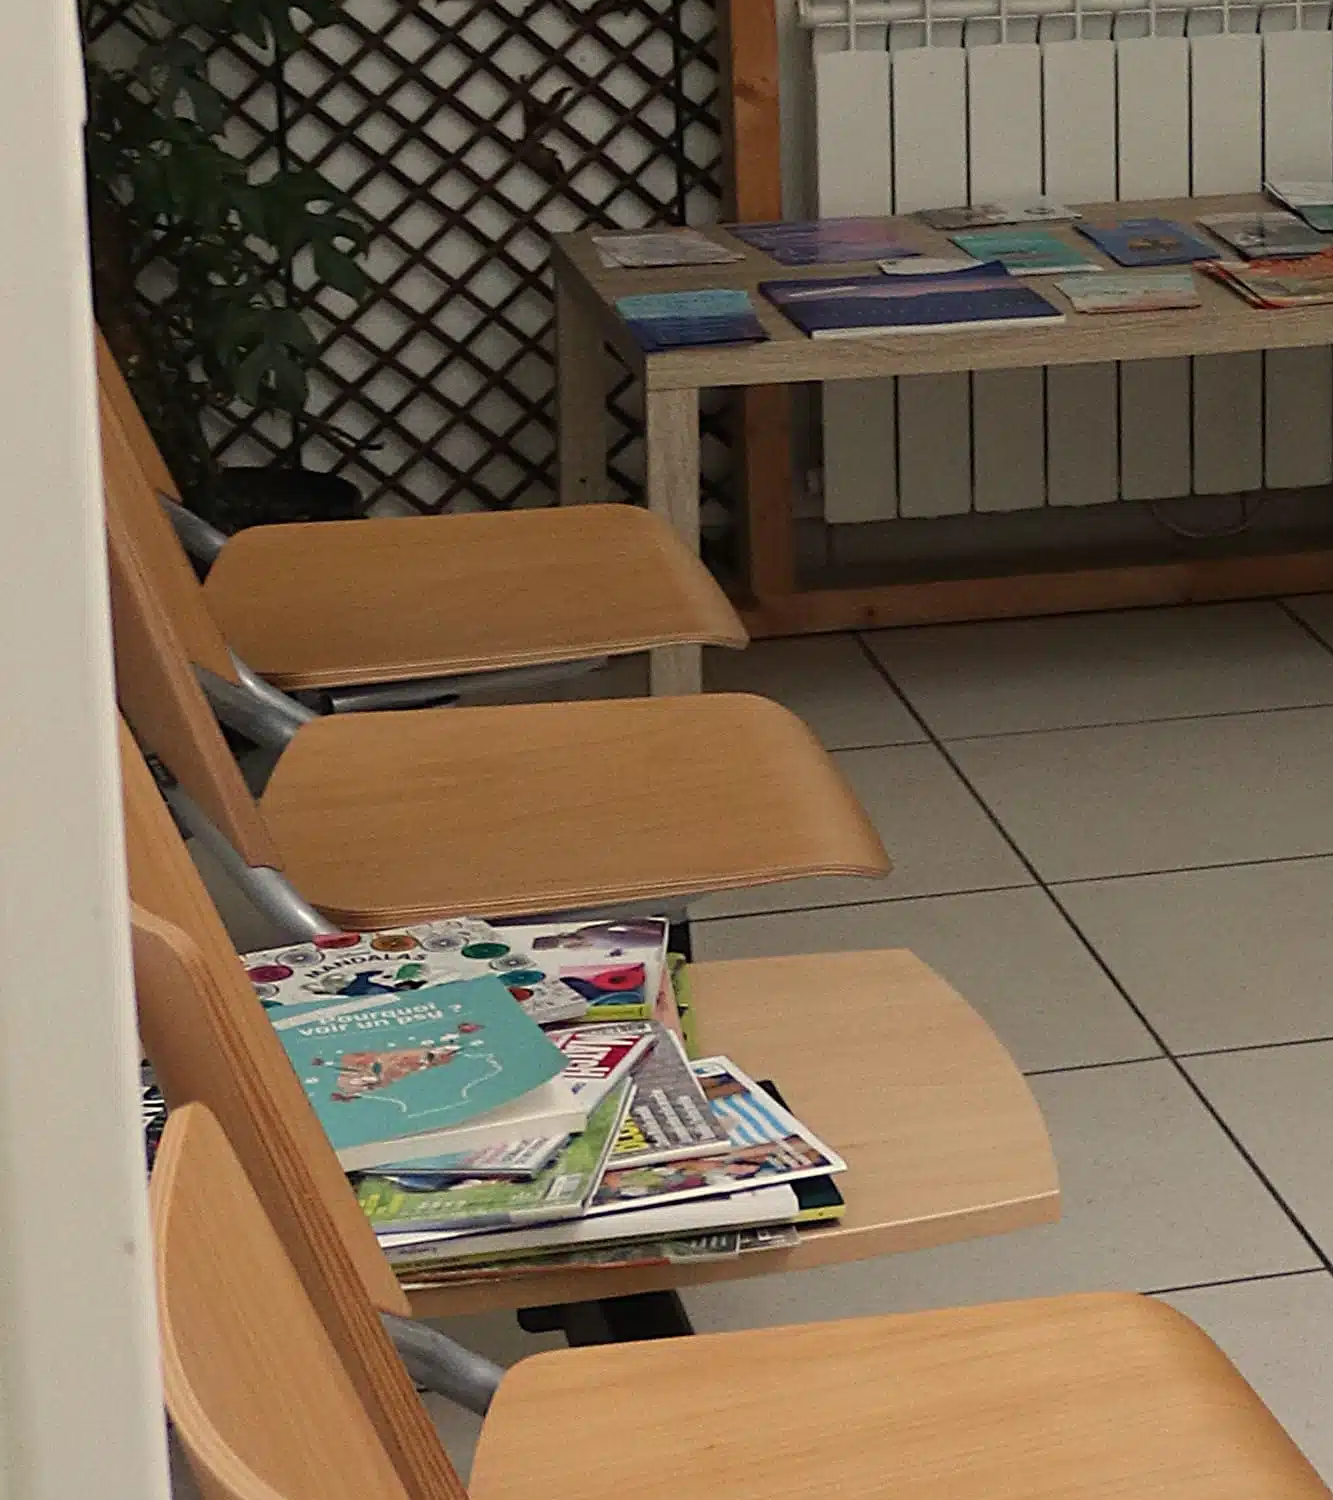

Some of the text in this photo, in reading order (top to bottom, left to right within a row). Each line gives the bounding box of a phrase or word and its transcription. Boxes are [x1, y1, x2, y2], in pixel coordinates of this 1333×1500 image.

[304, 952, 429, 979] MANDALAS
[298, 1022, 349, 1037] voir
[356, 1018, 391, 1031] un
